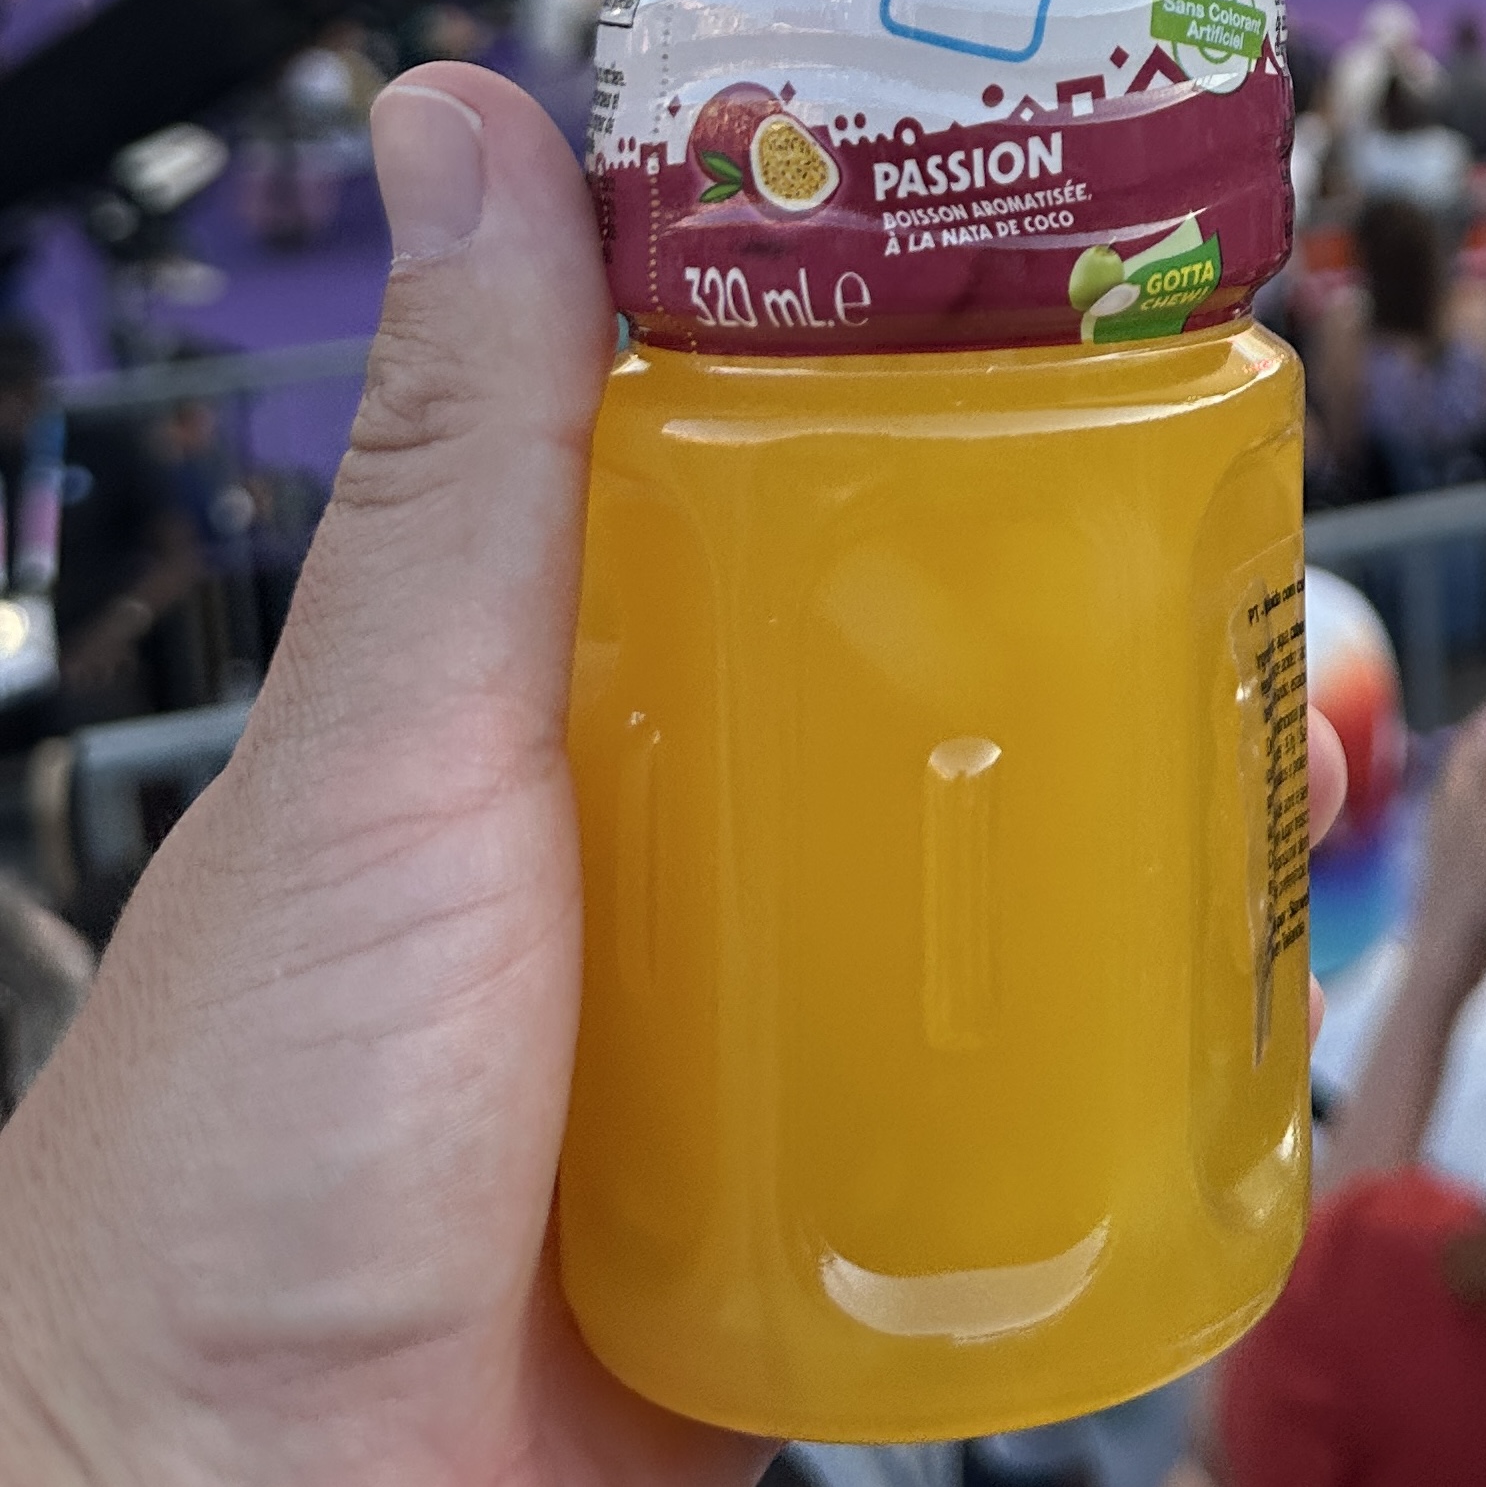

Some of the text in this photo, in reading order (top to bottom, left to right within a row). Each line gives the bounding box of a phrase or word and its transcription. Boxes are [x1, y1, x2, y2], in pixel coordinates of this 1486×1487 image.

[1186, 19, 1245, 51] Artificiel
[1208, 1, 1262, 35] Colorant
[873, 131, 1063, 201] PASSION
[882, 203, 969, 231] BOISSON
[884, 210, 1075, 257] À LA NATA DE COCO
[1146, 258, 1214, 294] GOTTA
[684, 266, 758, 328] 320
